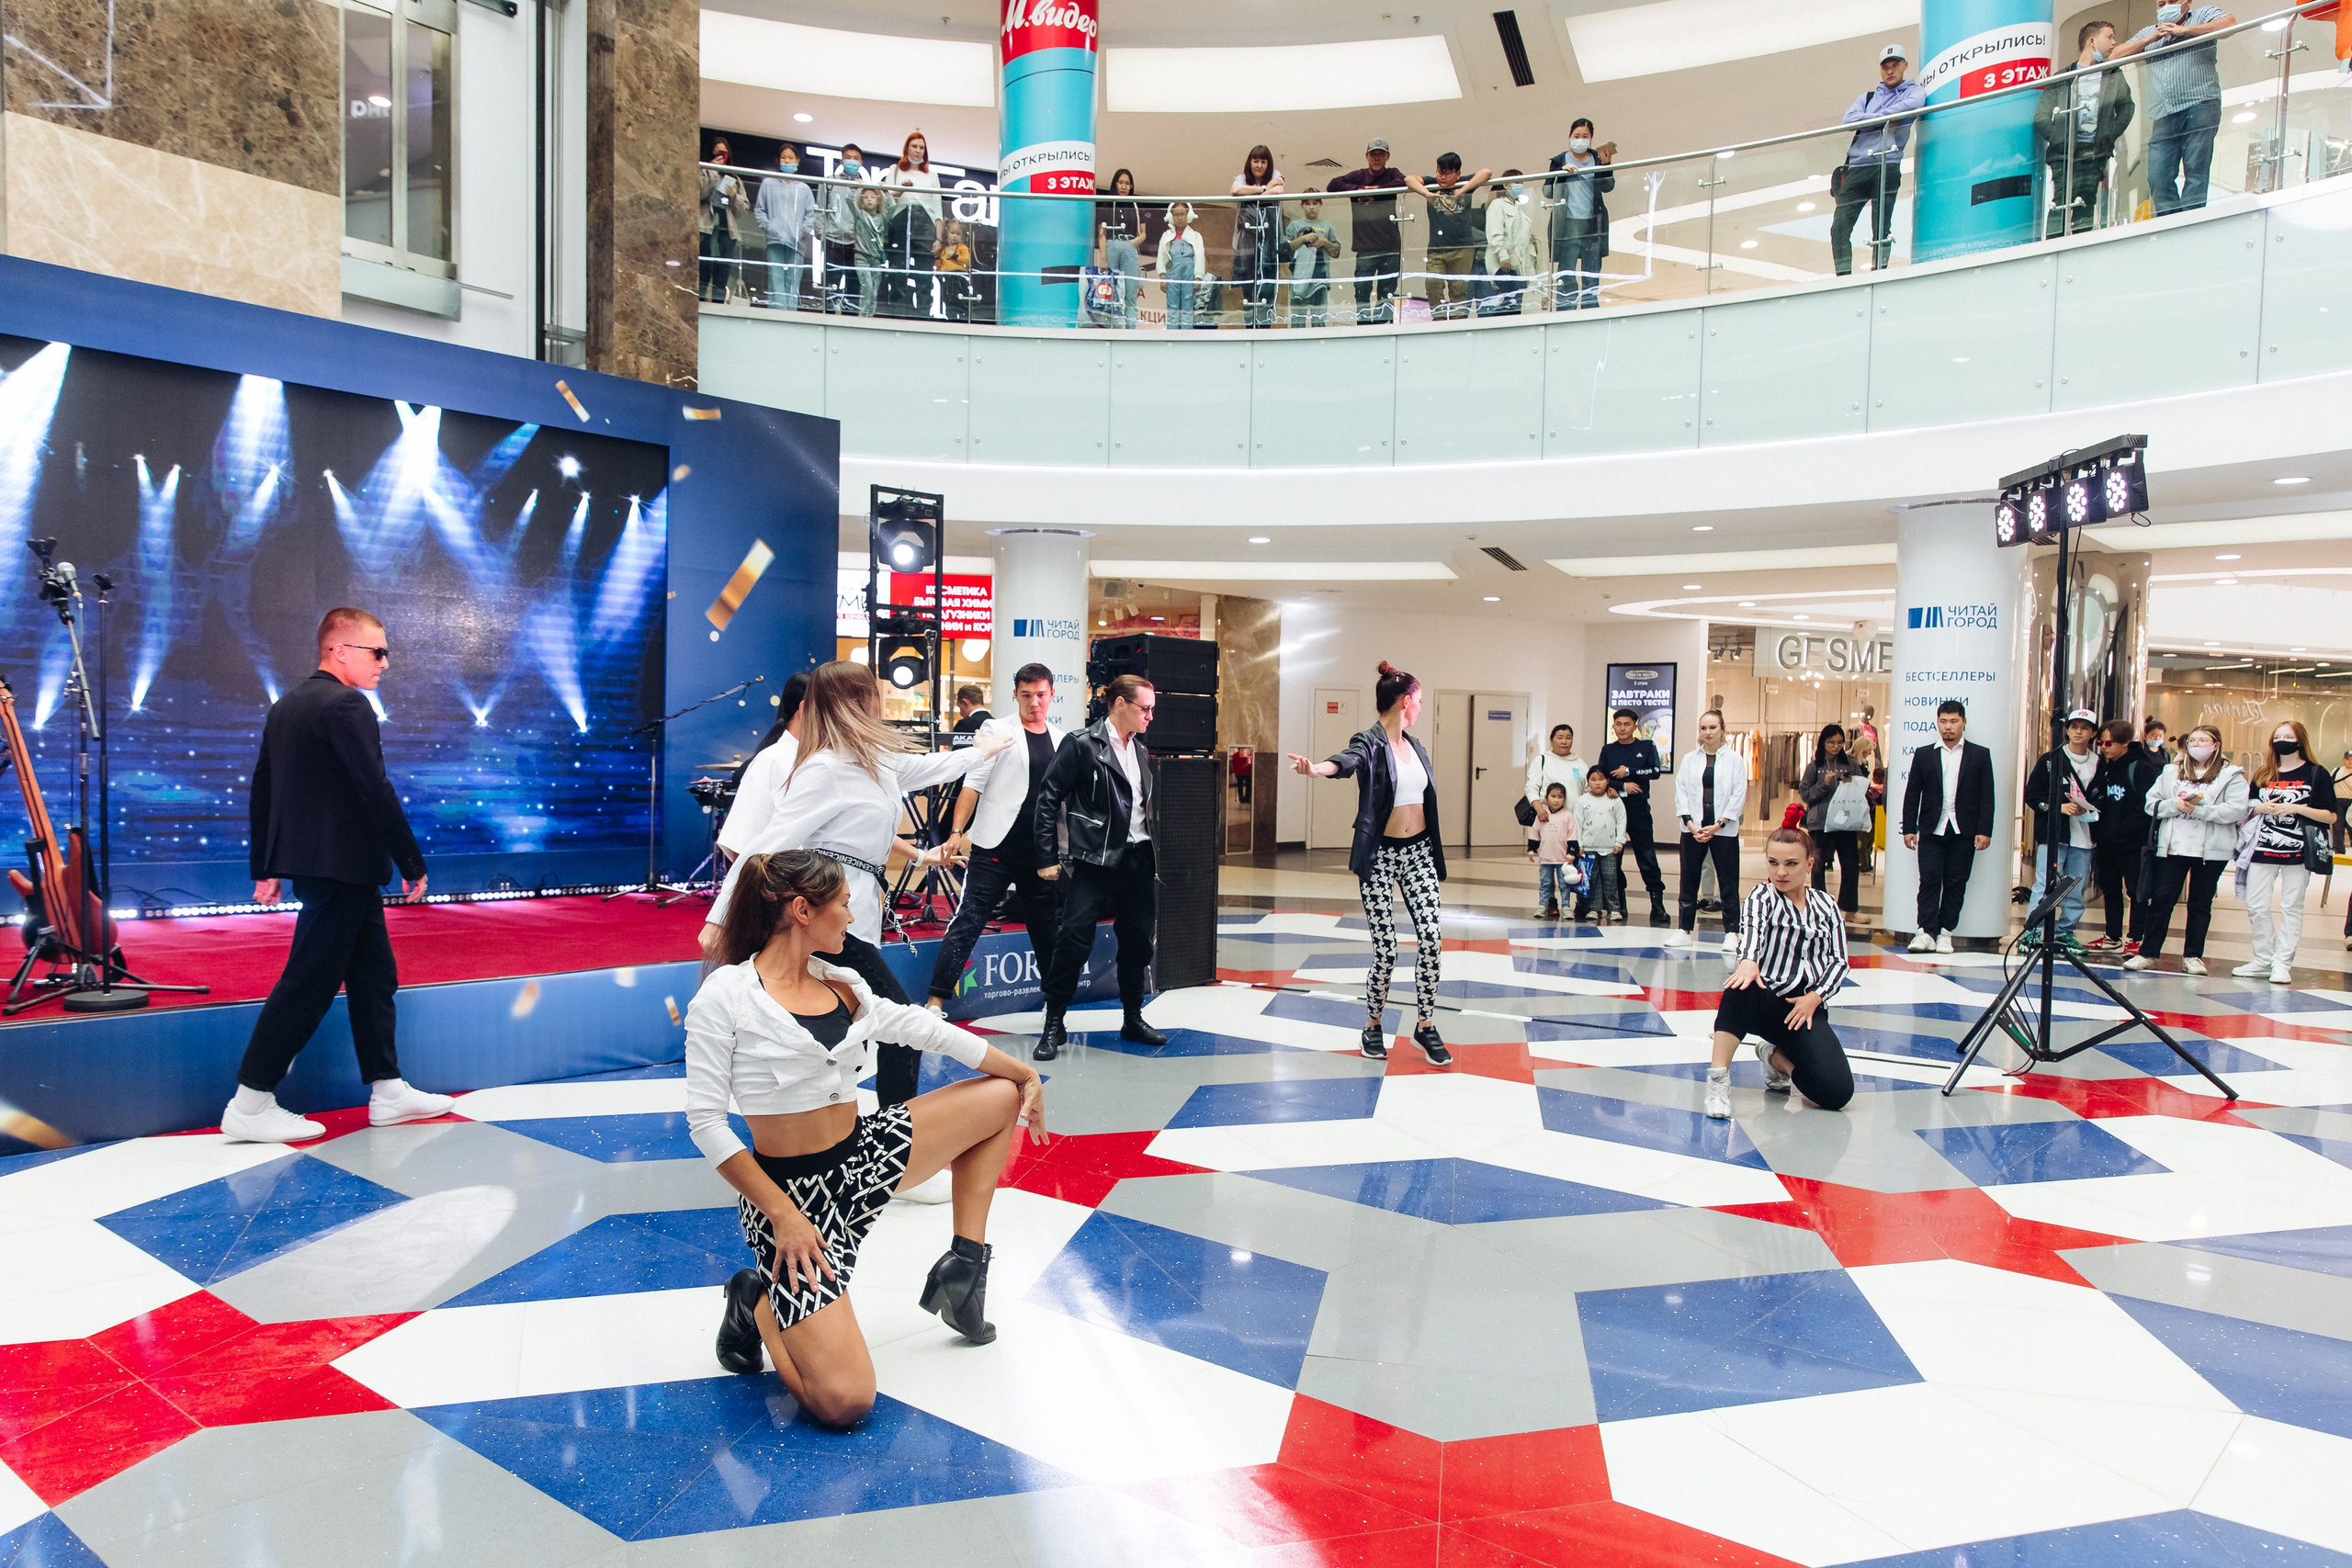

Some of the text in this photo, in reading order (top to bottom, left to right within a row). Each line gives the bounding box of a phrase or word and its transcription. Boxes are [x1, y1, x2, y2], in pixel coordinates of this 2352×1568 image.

[1001, 0, 1098, 38] М.видео
[1939, 35, 2046, 73] ОТКРЫЛИСЬ!
[2001, 66, 2049, 84] ЭТАЖ
[1013, 152, 1092, 169] ОТКРЫЛИСЬ!
[1059, 176, 1094, 190] ЭТАЖ
[913, 596, 961, 607] БЫТВАЯ
[922, 609, 990, 620] ПДГУЗНИКИ
[1948, 604, 1997, 616] ЧИТАЙ
[1046, 619, 1080, 631] ЧИТАЙ
[1948, 617, 1997, 629] ГОРОД
[1046, 629, 1080, 641] ГОРОД
[1905, 671, 1996, 682] БЕСТСЕЛЛЕРЫ
[1611, 690, 1670, 699] ЗАВТРАКИ
